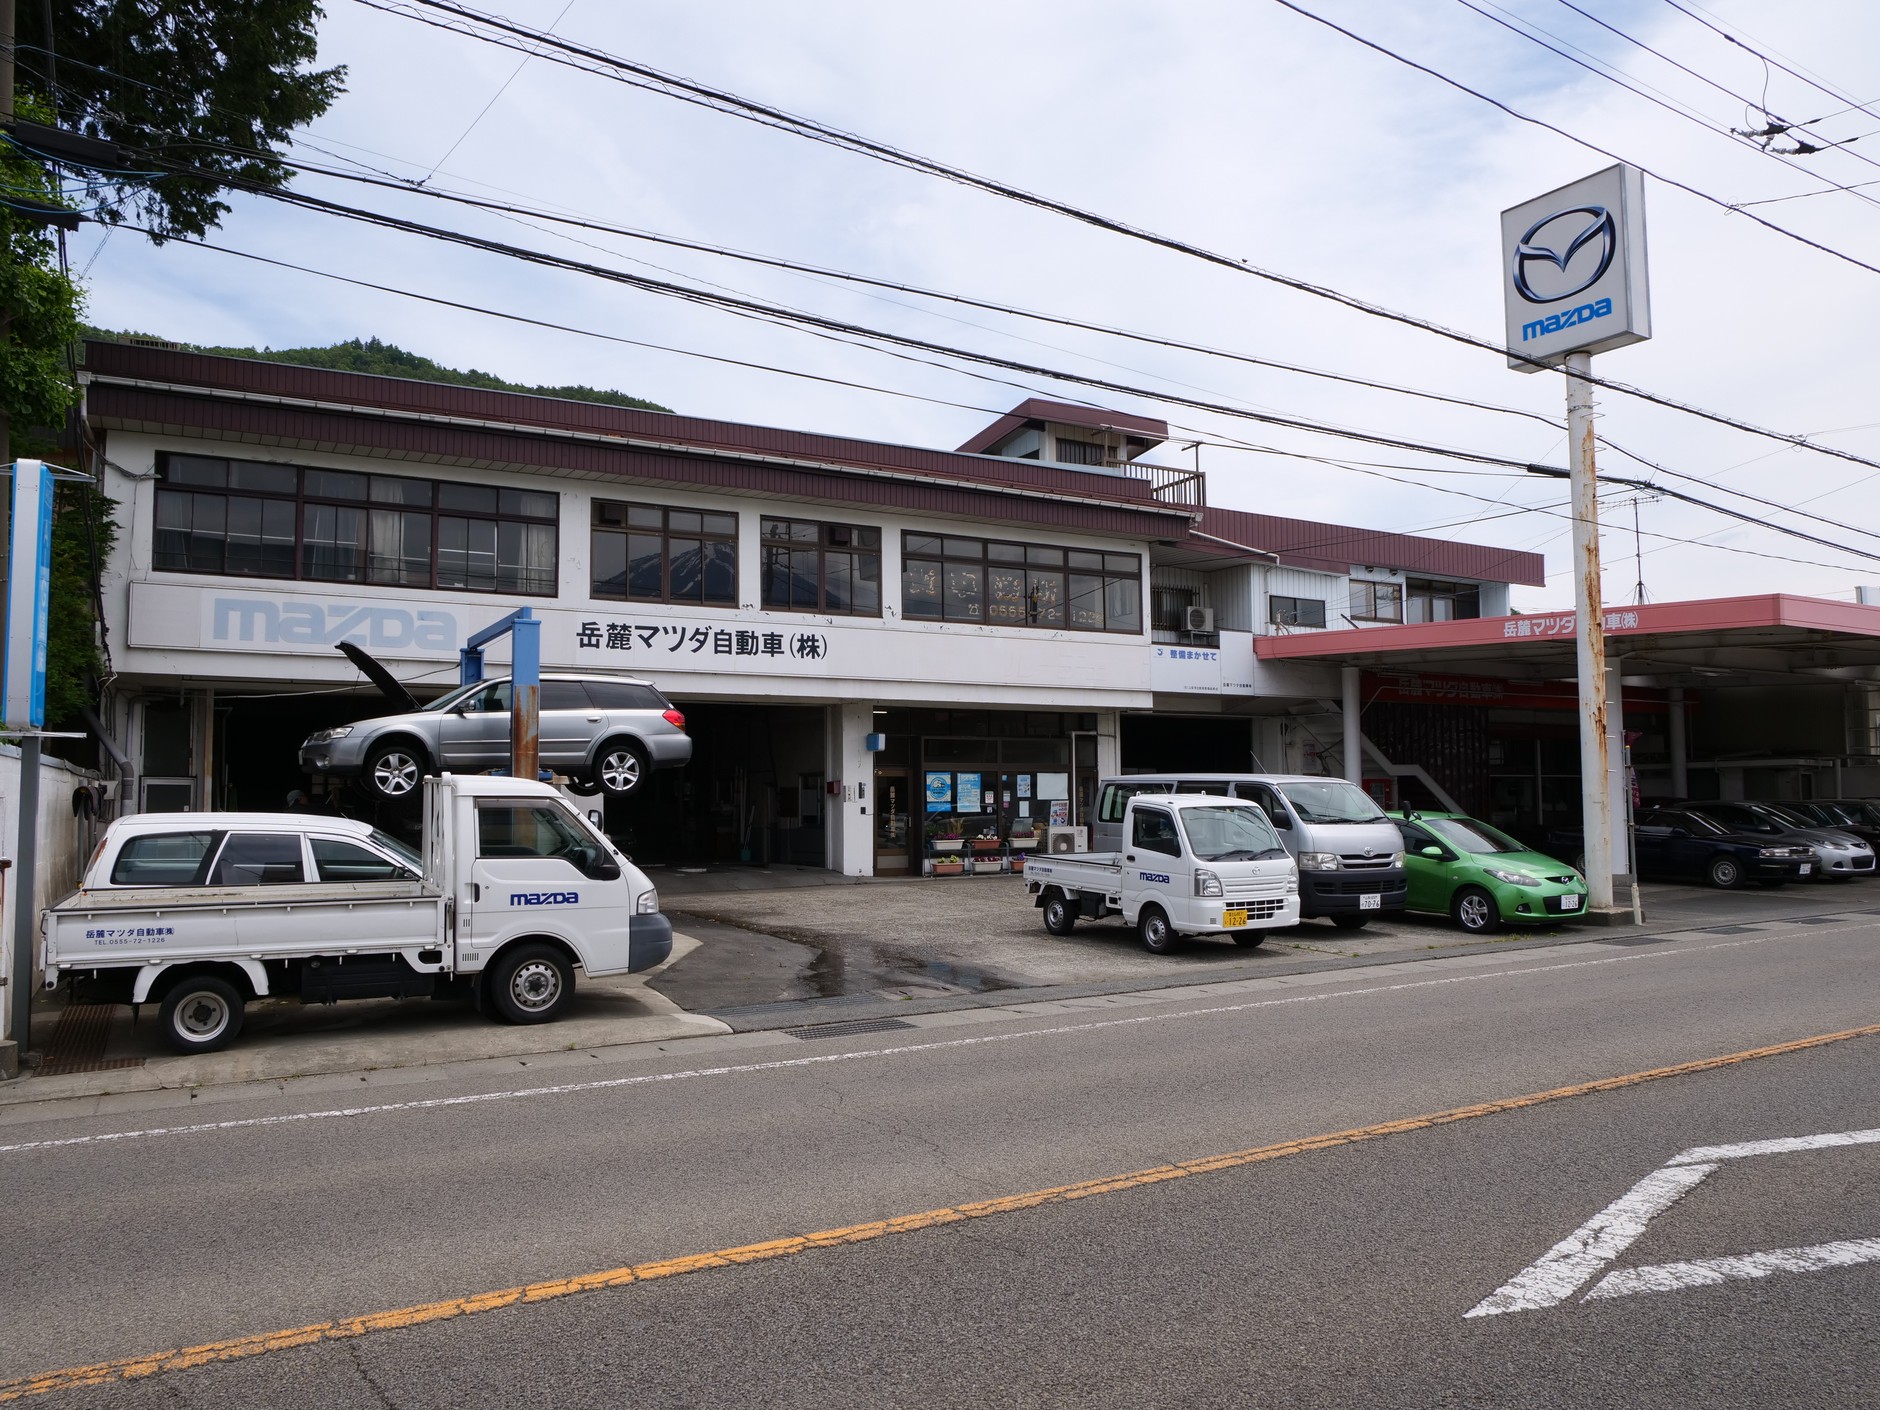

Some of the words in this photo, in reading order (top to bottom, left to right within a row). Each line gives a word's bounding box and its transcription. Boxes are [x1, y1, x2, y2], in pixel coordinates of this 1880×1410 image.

[1522, 297, 1612, 341] mazda
[213, 598, 457, 651] mazda
[1504, 611, 1638, 637] 岳麓マツダ車(株)
[576, 621, 828, 660] 岳麓マツダ自動車(株)
[1170, 649, 1217, 661] 整備まかせて
[1139, 872, 1170, 884] mazda
[510, 892, 579, 906] mazda
